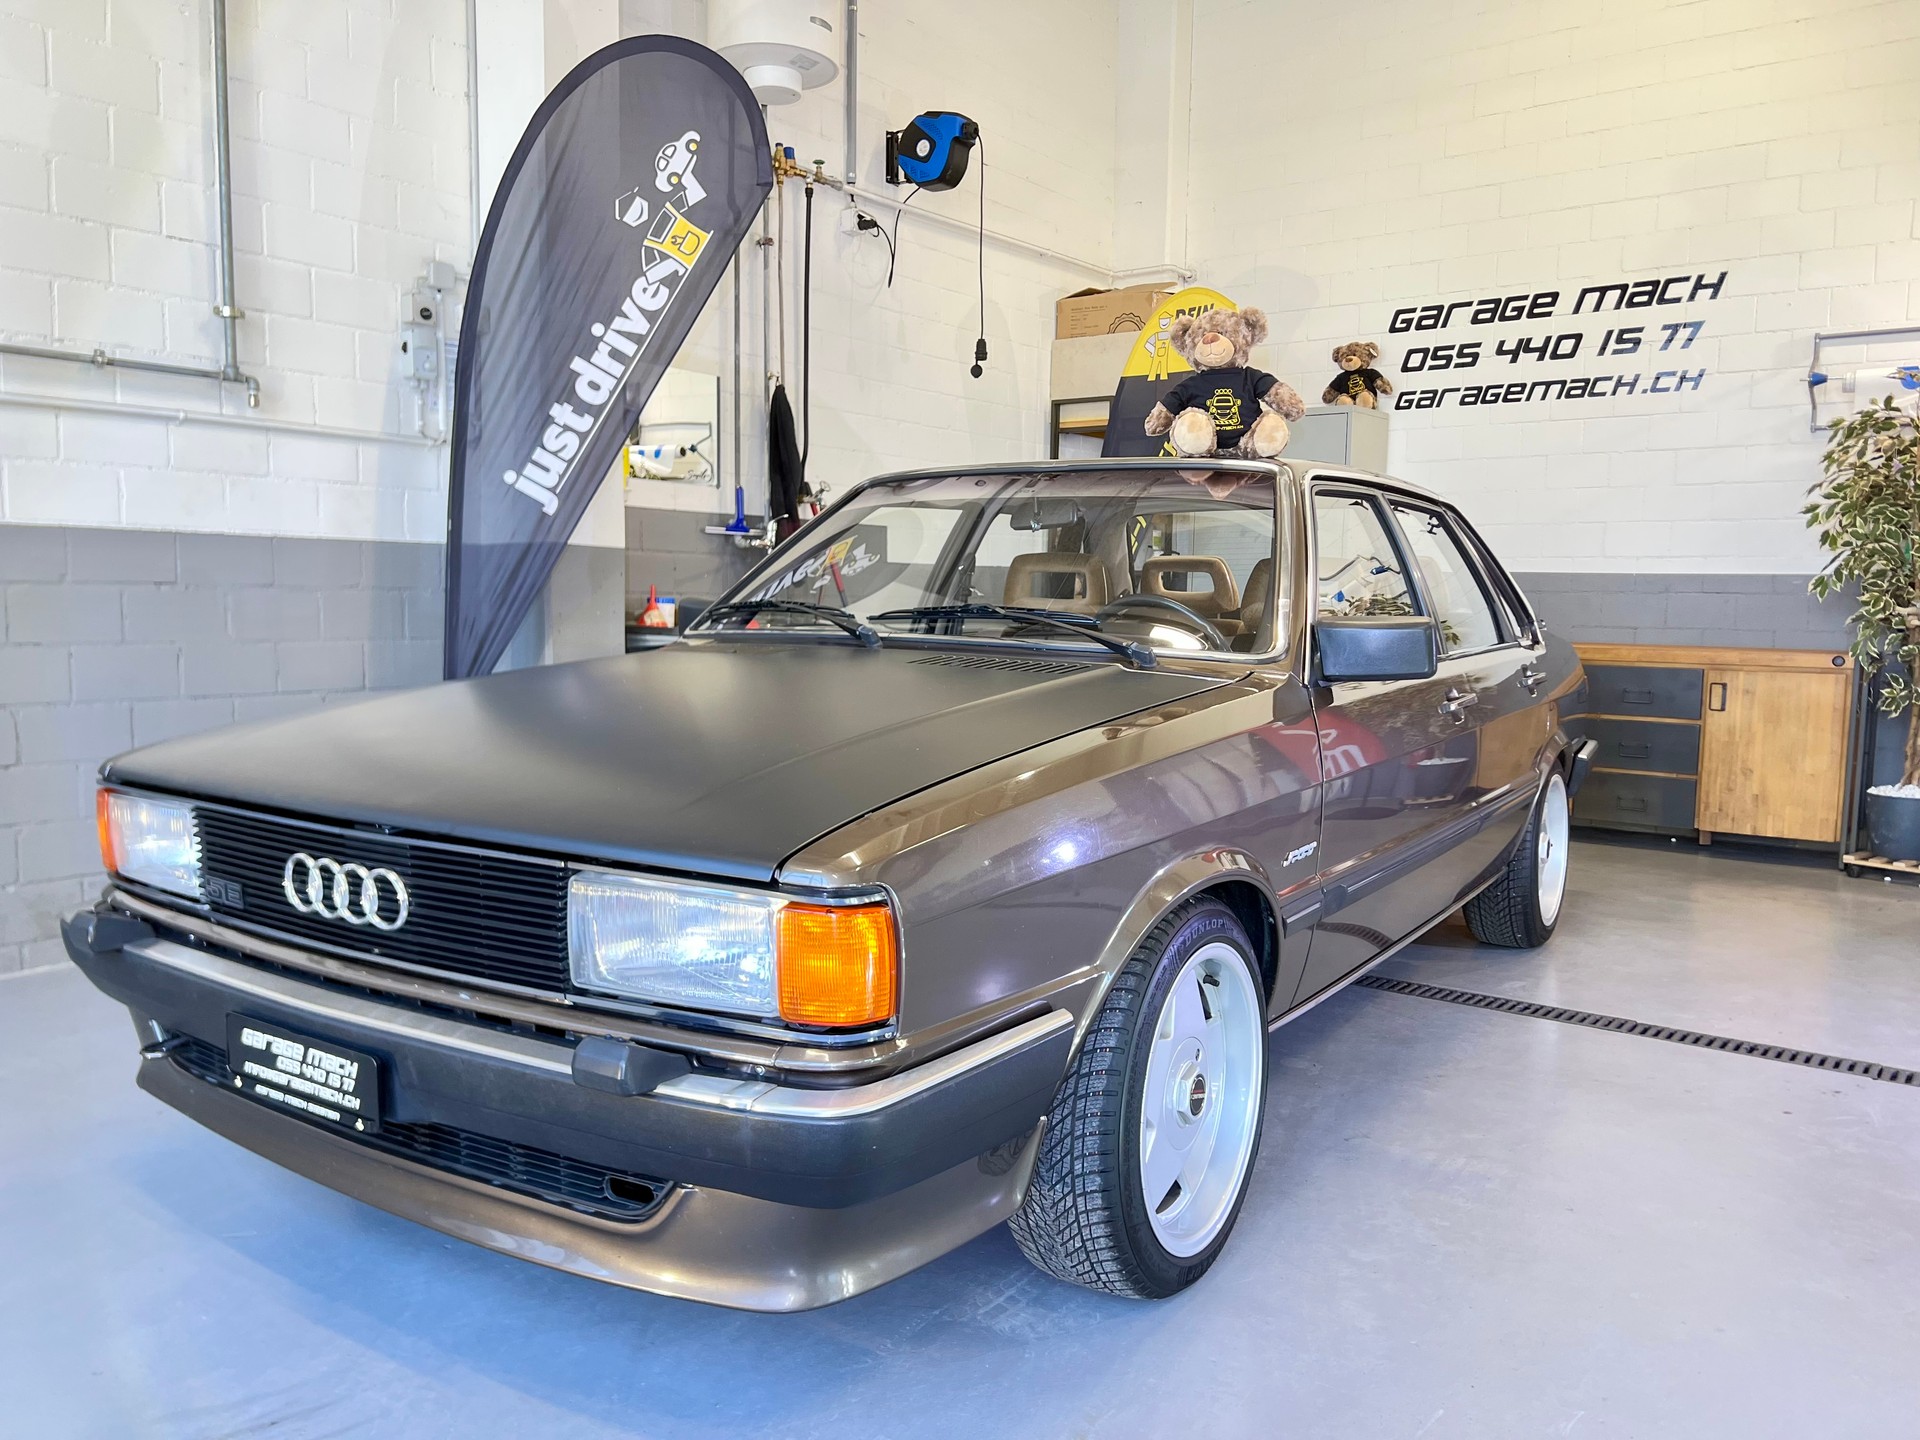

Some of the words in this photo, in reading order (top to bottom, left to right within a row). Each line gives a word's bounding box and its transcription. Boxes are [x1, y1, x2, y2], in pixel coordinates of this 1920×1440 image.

[1400, 342, 1483, 374] 055
[1494, 332, 1583, 364] 440
[1596, 327, 1646, 357] 15
[1659, 320, 1706, 351] 77
[503, 402, 595, 517] just
[1185, 918, 1224, 947] DUNLOP
[276, 1055, 301, 1075] 055
